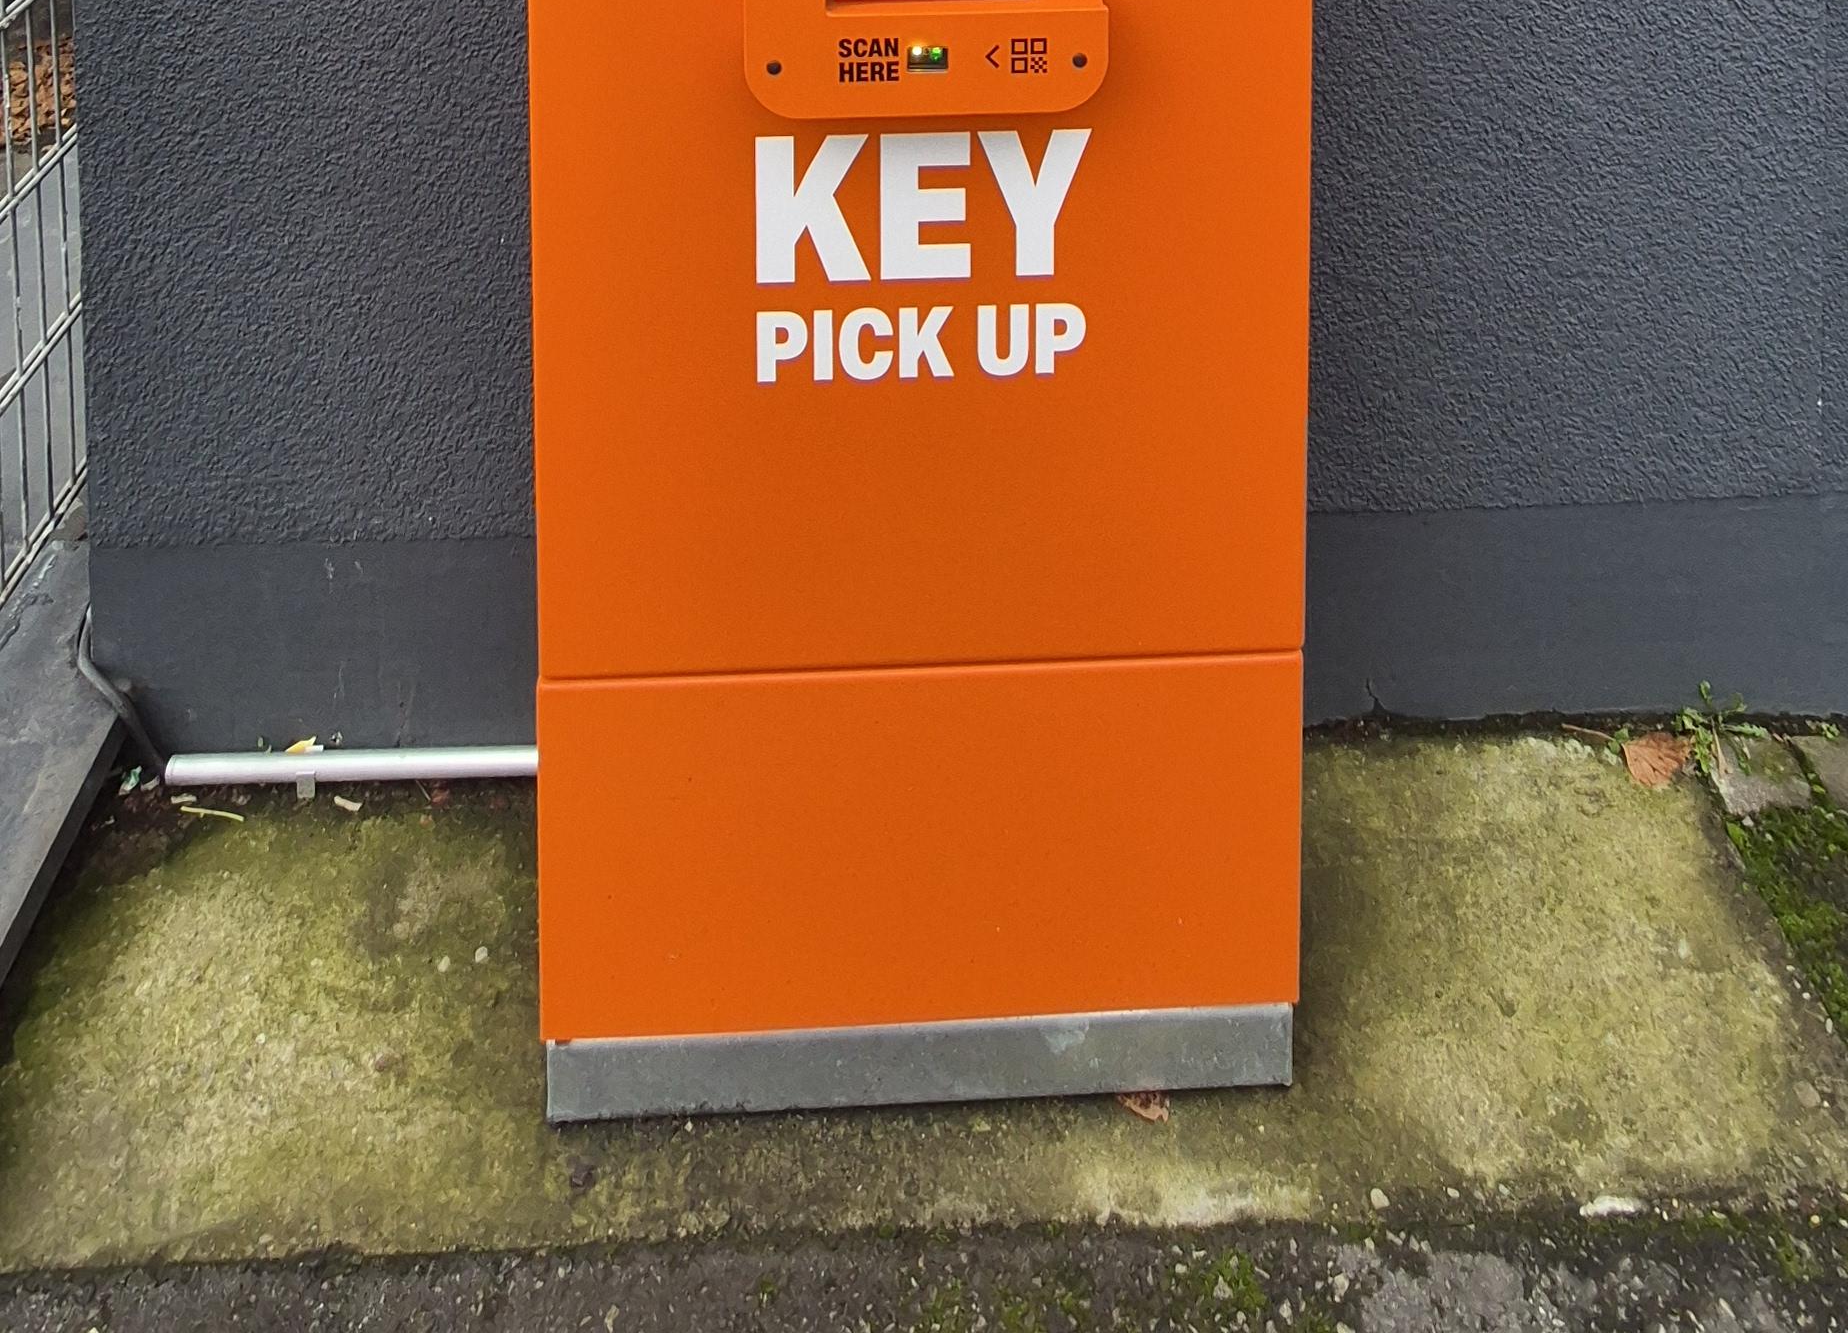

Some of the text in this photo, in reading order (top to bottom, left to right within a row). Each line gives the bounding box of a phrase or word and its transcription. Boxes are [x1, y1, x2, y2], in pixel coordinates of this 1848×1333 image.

[838, 38, 899, 58] SCAN
[839, 62, 899, 82] HERE
[755, 128, 1092, 283] KEY
[756, 302, 1087, 383] PICK UP
